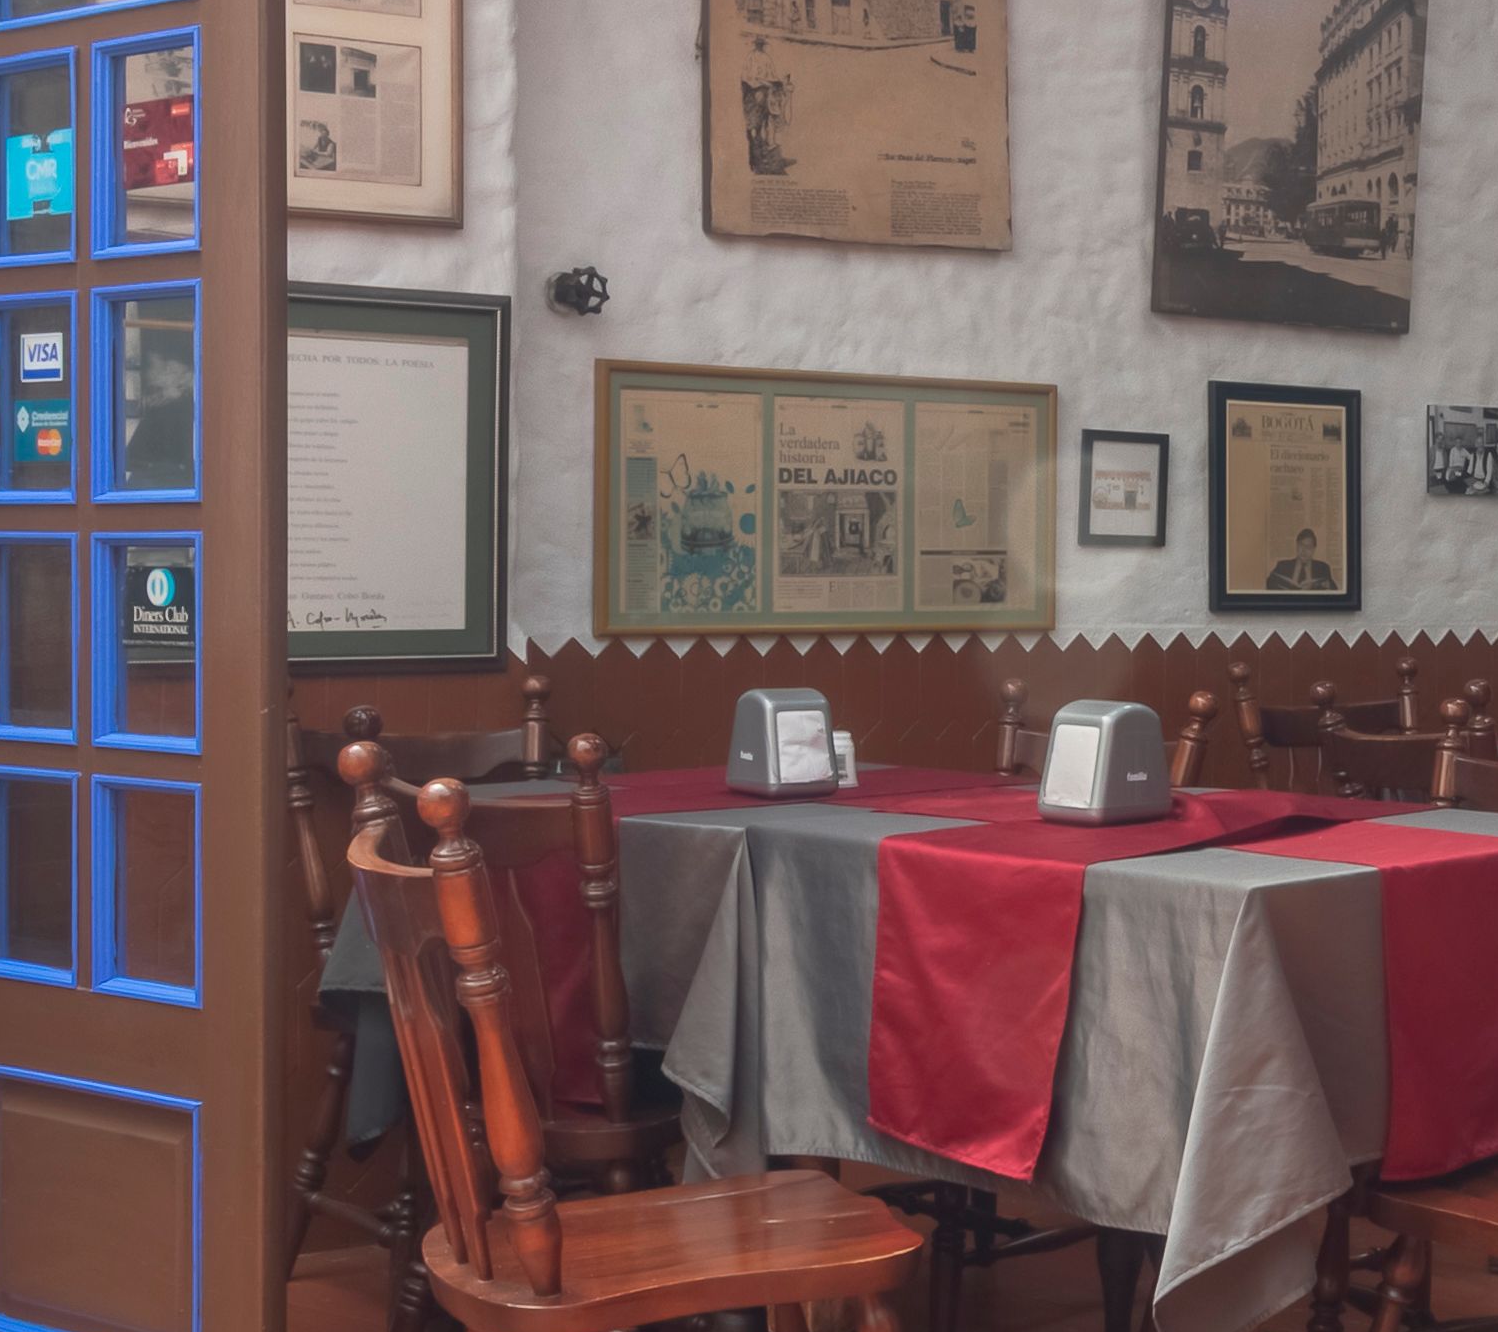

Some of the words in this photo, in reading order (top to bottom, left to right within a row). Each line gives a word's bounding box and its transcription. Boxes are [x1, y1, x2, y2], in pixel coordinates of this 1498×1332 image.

[28, 342, 59, 363] VISA
[779, 422, 796, 436] La
[1262, 414, 1314, 431] BOGOTÁ
[779, 436, 841, 450] verdadera
[778, 450, 826, 464] historia
[778, 467, 818, 485] DEL
[823, 468, 898, 486] AJIACO
[133, 605, 164, 623] Diners
[165, 605, 189, 623] Club
[133, 623, 189, 635] INTERNATIONAL
